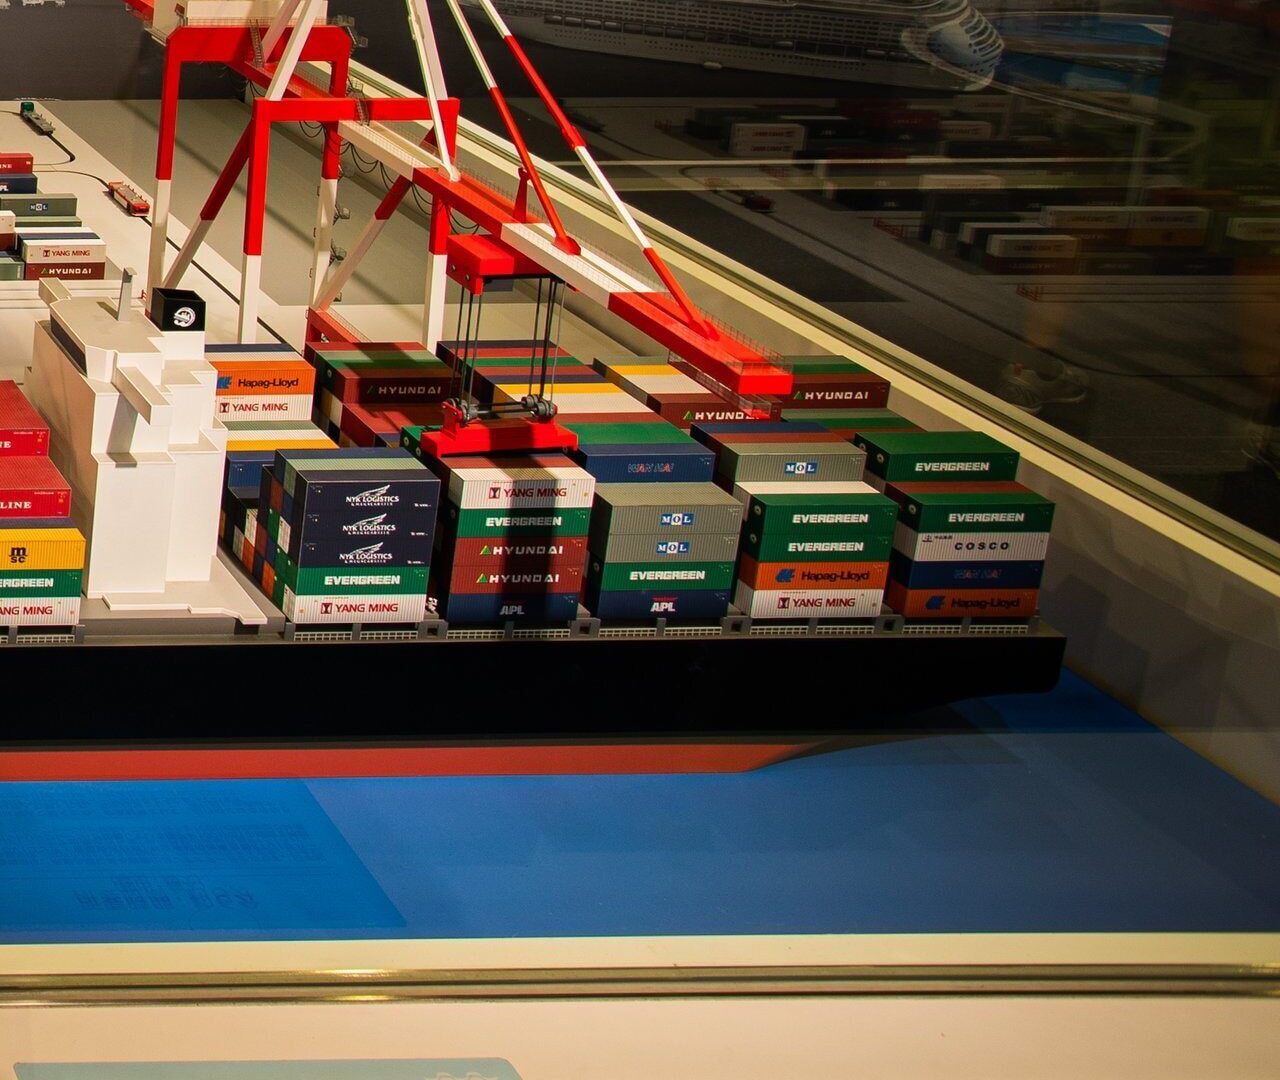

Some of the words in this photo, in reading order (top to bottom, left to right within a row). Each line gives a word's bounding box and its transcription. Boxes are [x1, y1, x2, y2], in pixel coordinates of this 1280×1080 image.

[237, 378, 299, 388] Hapag-Lloyd
[804, 391, 868, 399] HYUNDAI
[232, 403, 259, 411] YANG
[261, 402, 288, 411] MING
[915, 462, 989, 471] EVERGREEN
[504, 488, 534, 497] YANG
[536, 487, 567, 497] MING
[0, 501, 31, 509] LINE
[485, 516, 562, 526] EVERGREEN
[661, 514, 692, 525] MOL
[792, 513, 868, 523] EVERGREEN
[954, 541, 1009, 550] COSCO
[324, 575, 400, 585] EVERGREEN
[629, 570, 705, 580] EVERGREEN
[801, 571, 870, 582] Hapag-Lloyd
[793, 598, 822, 607] YANG
[825, 597, 855, 607] MING
[950, 598, 1020, 609] Hapag-Lloyd
